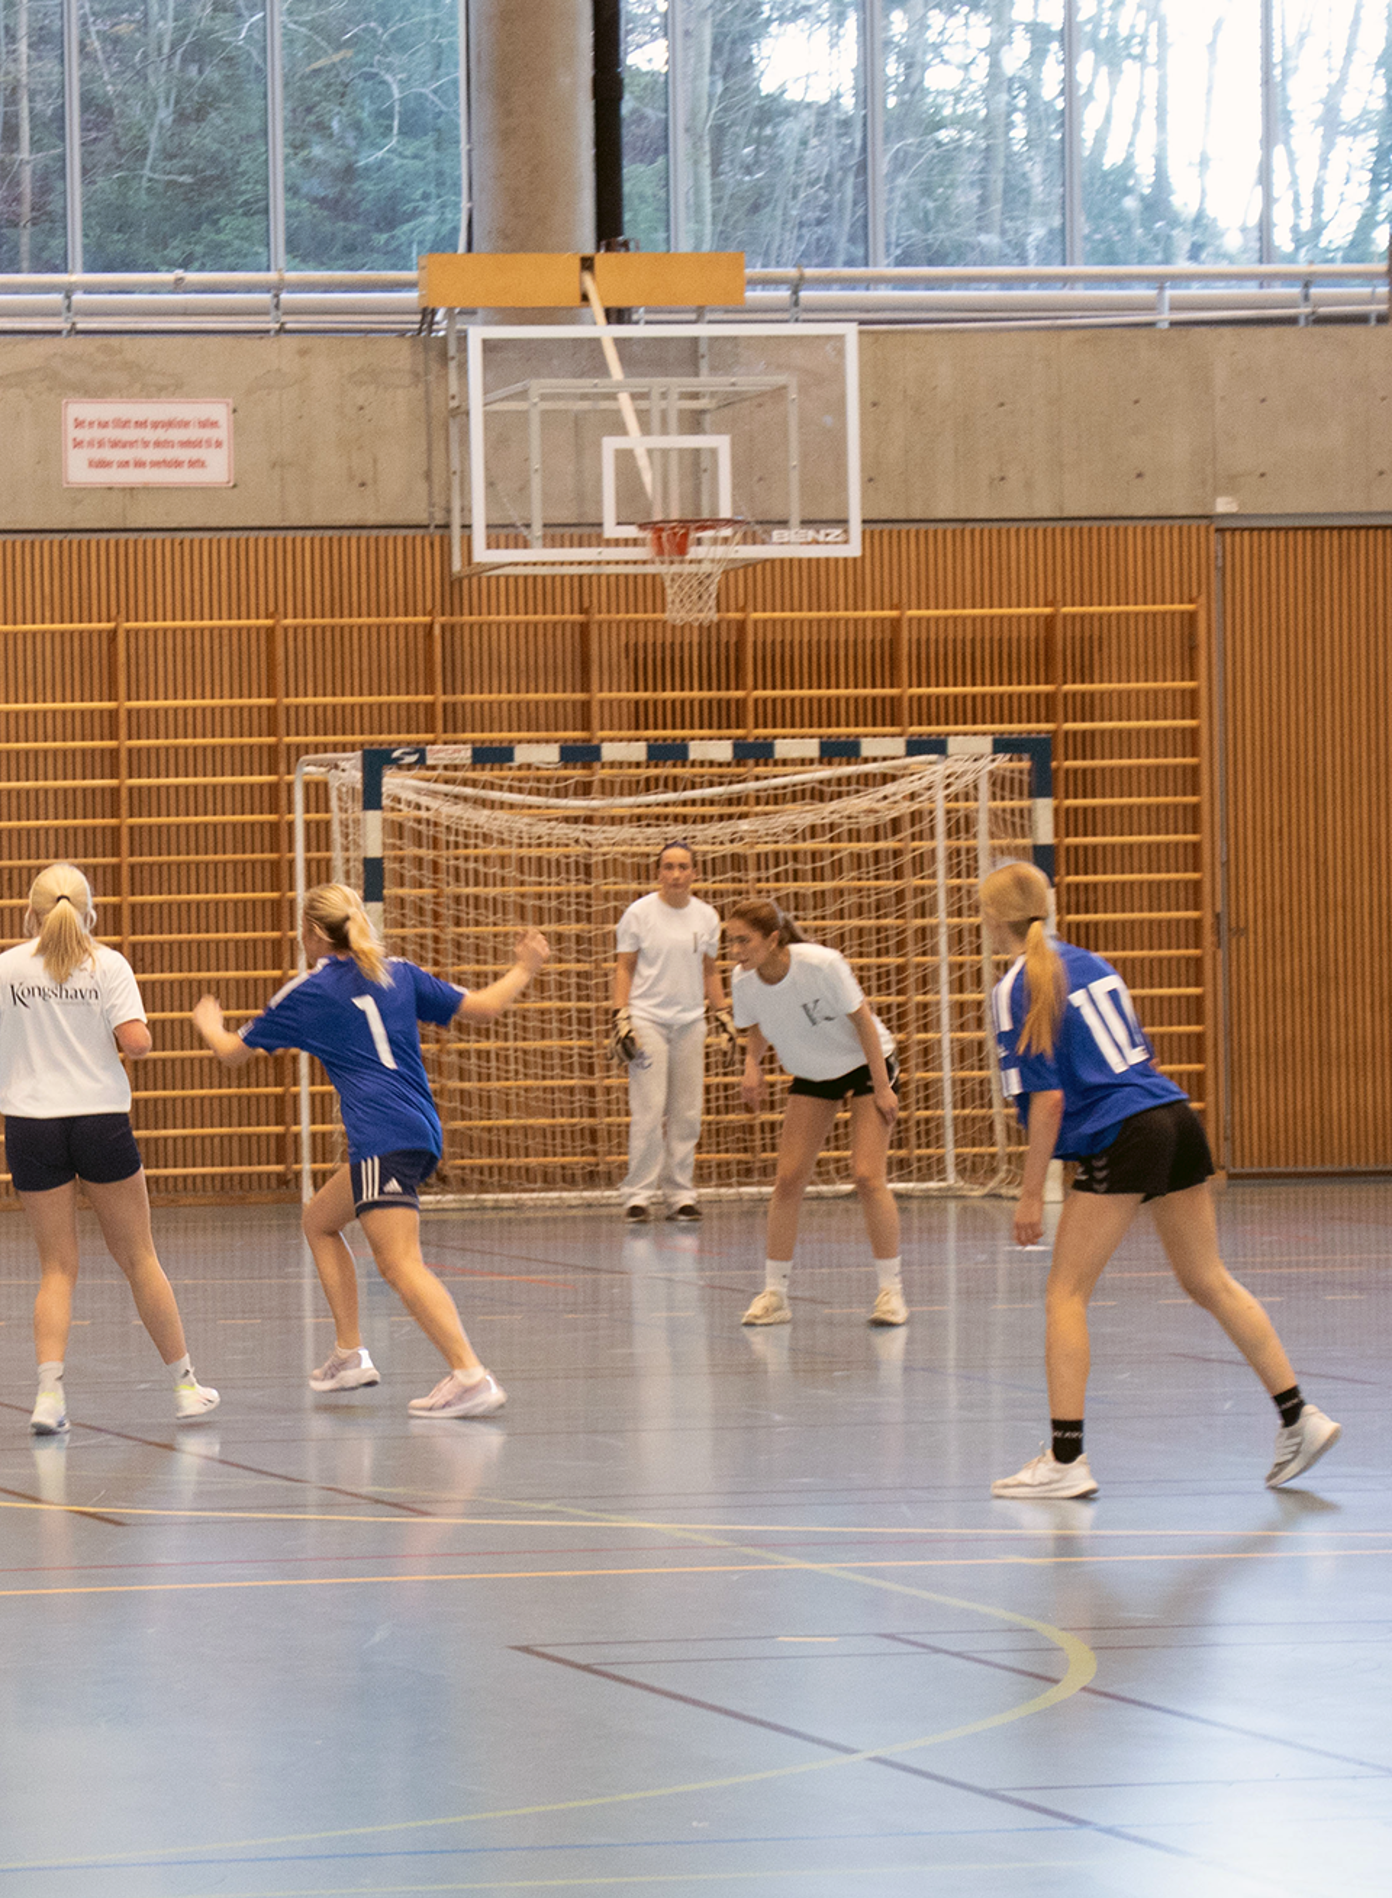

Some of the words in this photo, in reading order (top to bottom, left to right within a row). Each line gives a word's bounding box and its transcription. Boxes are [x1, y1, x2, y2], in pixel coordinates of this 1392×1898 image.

[73, 417, 86, 429] Det
[72, 437, 85, 448] Det
[772, 528, 847, 542] BENZ
[10, 982, 99, 1010] Kongshavn
[801, 998, 836, 1026] K
[1067, 974, 1150, 1075] 10
[350, 993, 398, 1070] 1
